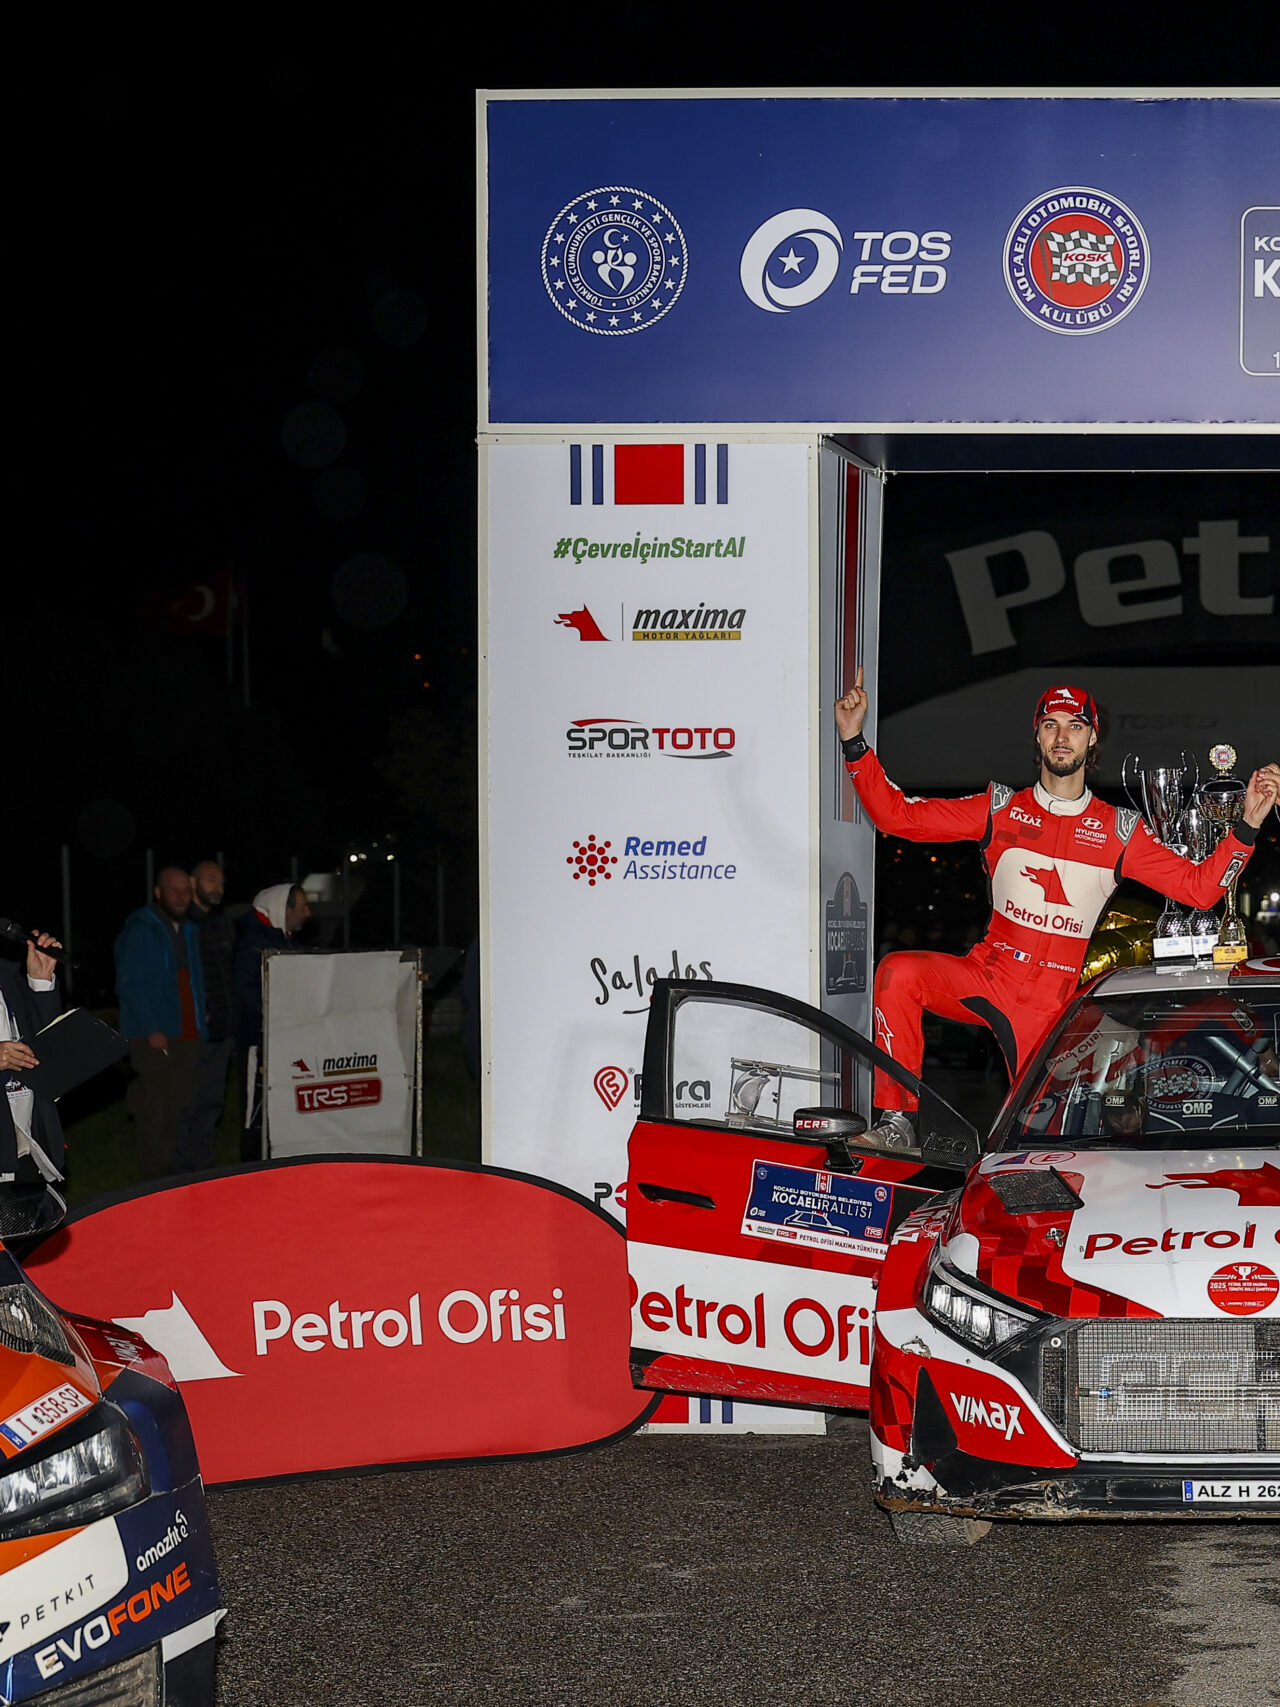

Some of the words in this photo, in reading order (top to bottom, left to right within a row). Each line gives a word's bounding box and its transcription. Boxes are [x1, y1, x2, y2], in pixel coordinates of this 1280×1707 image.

[601, 213, 642, 229] GENÇLİK
[641, 225, 651, 237] VE
[568, 217, 600, 275] CUMHURİYETİ
[650, 237, 661, 262] SPOR
[852, 231, 952, 262] TOS
[1063, 253, 1109, 262] KOSK
[1113, 215, 1141, 303] SPORLARI
[849, 265, 947, 294] FED
[572, 277, 603, 307] TÜRKİYE
[1039, 302, 1112, 325] KULÜBÜ
[633, 602, 746, 630] maxima
[643, 632, 679, 640] MOTOR
[684, 630, 731, 640] YAĞLARI
[1009, 810, 1042, 828] KAZAZ
[1074, 833, 1106, 844] MOTORSPORT
[1075, 827, 1107, 839] HYUNDAI
[624, 836, 707, 857] Remed
[623, 860, 737, 880] Assistance
[1005, 900, 1049, 928] Petrol
[1051, 914, 1084, 933] Ofisi
[323, 1053, 378, 1071] maxima
[299, 1085, 348, 1108] TRS
[1105, 1096, 1125, 1105] OMP
[1258, 1096, 1278, 1105] OMP
[1183, 1102, 1213, 1115] OMP
[796, 1119, 829, 1129] PCRS
[799, 1234, 820, 1243] PETROL
[835, 1241, 856, 1250] MAXIMA
[866, 1227, 883, 1237] TRS
[1084, 1223, 1256, 1259] Petrol
[252, 1292, 423, 1356] Petrol
[437, 1287, 566, 1344] Ofisi
[784, 1297, 870, 1366] Ofi
[1198, 1485, 1232, 1498] ALZ
[1239, 1485, 1250, 1498] H
[20, 1574, 95, 1630] PETKIT
[34, 1561, 192, 1680] EVOFONE
